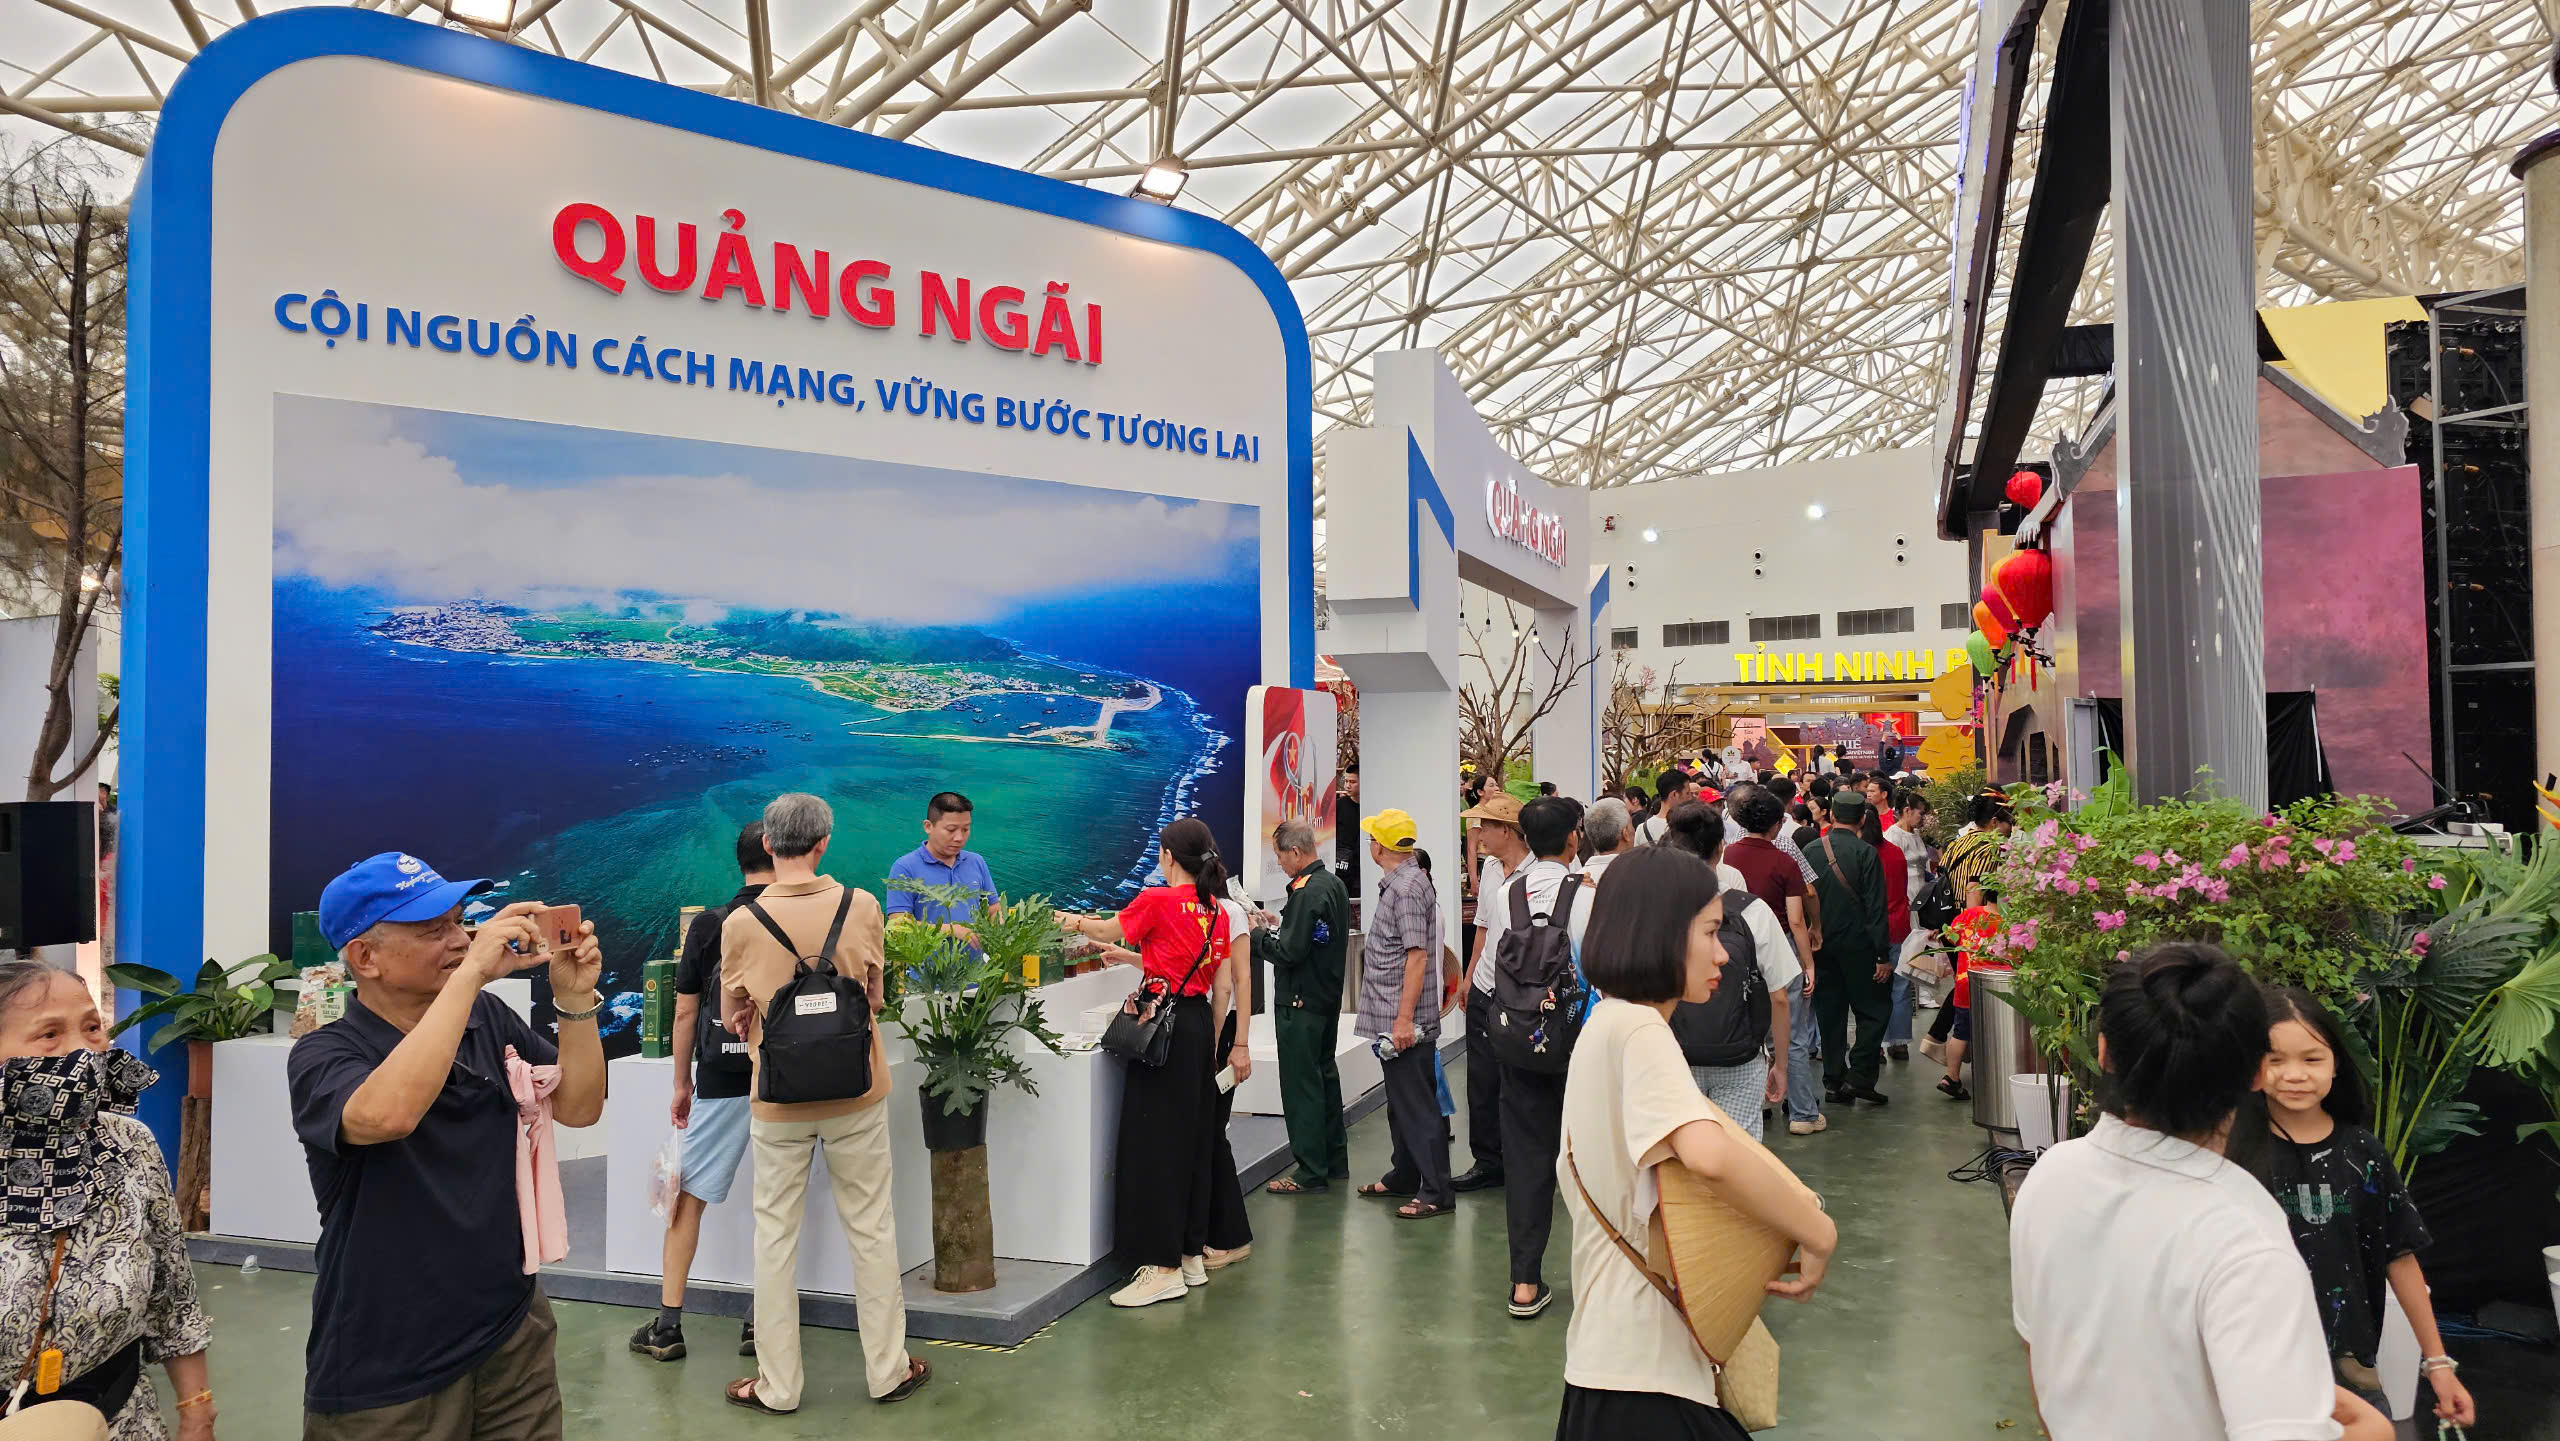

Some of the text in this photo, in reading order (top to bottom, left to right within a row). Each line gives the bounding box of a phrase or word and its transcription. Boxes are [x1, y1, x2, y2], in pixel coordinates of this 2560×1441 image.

[552, 203, 1103, 365] QUẢNG NGÃI
[275, 290, 1260, 463] CỘI NGUỒN CÁCH MẠNG, VỮNG BƯỚC TƯƠNG LAI
[1735, 641, 1824, 683] TỈNH
[1834, 648, 1935, 681] NINH
[721, 1042, 749, 1054] PUM
